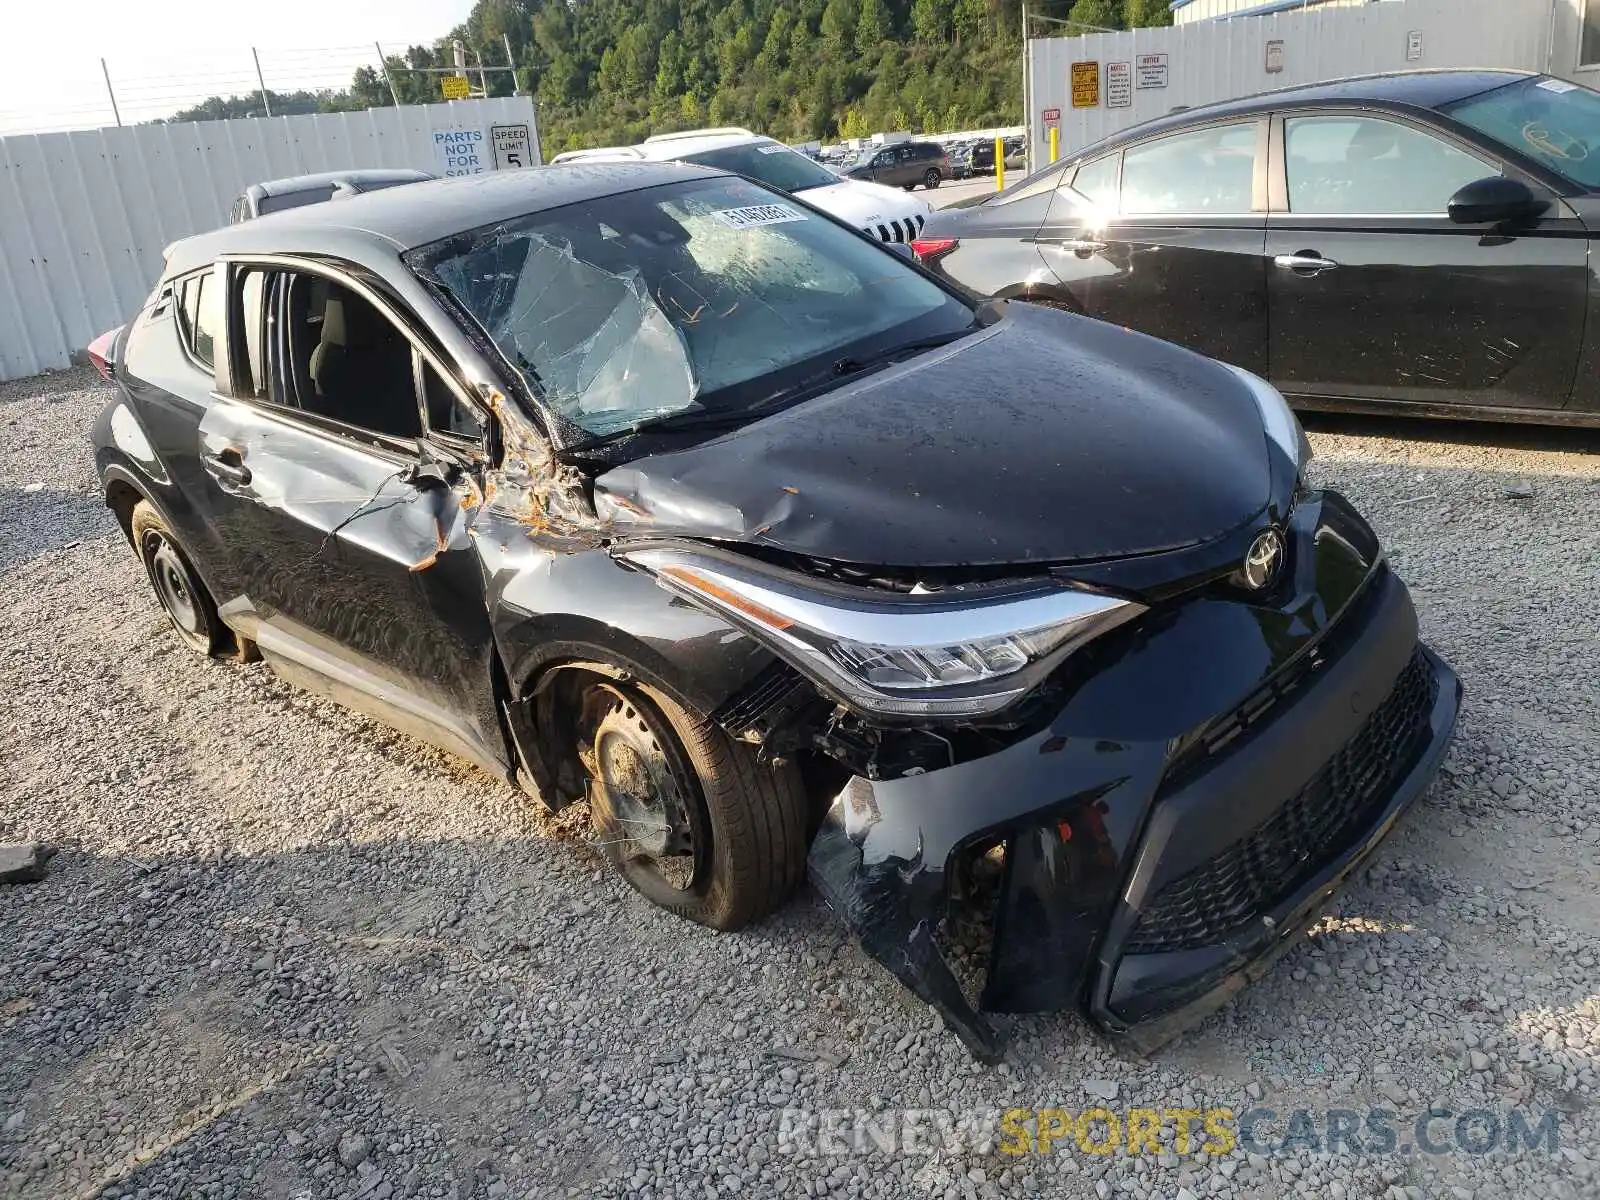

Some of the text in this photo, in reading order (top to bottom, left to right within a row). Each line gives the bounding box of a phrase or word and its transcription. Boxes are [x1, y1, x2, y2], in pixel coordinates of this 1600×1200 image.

[435, 131, 482, 144] PARTS
[495, 131, 526, 140] SPEED
[445, 143, 475, 155] NOT
[500, 142, 524, 151] LIMIT
[448, 155, 479, 167] FOR
[507, 153, 522, 168] 5
